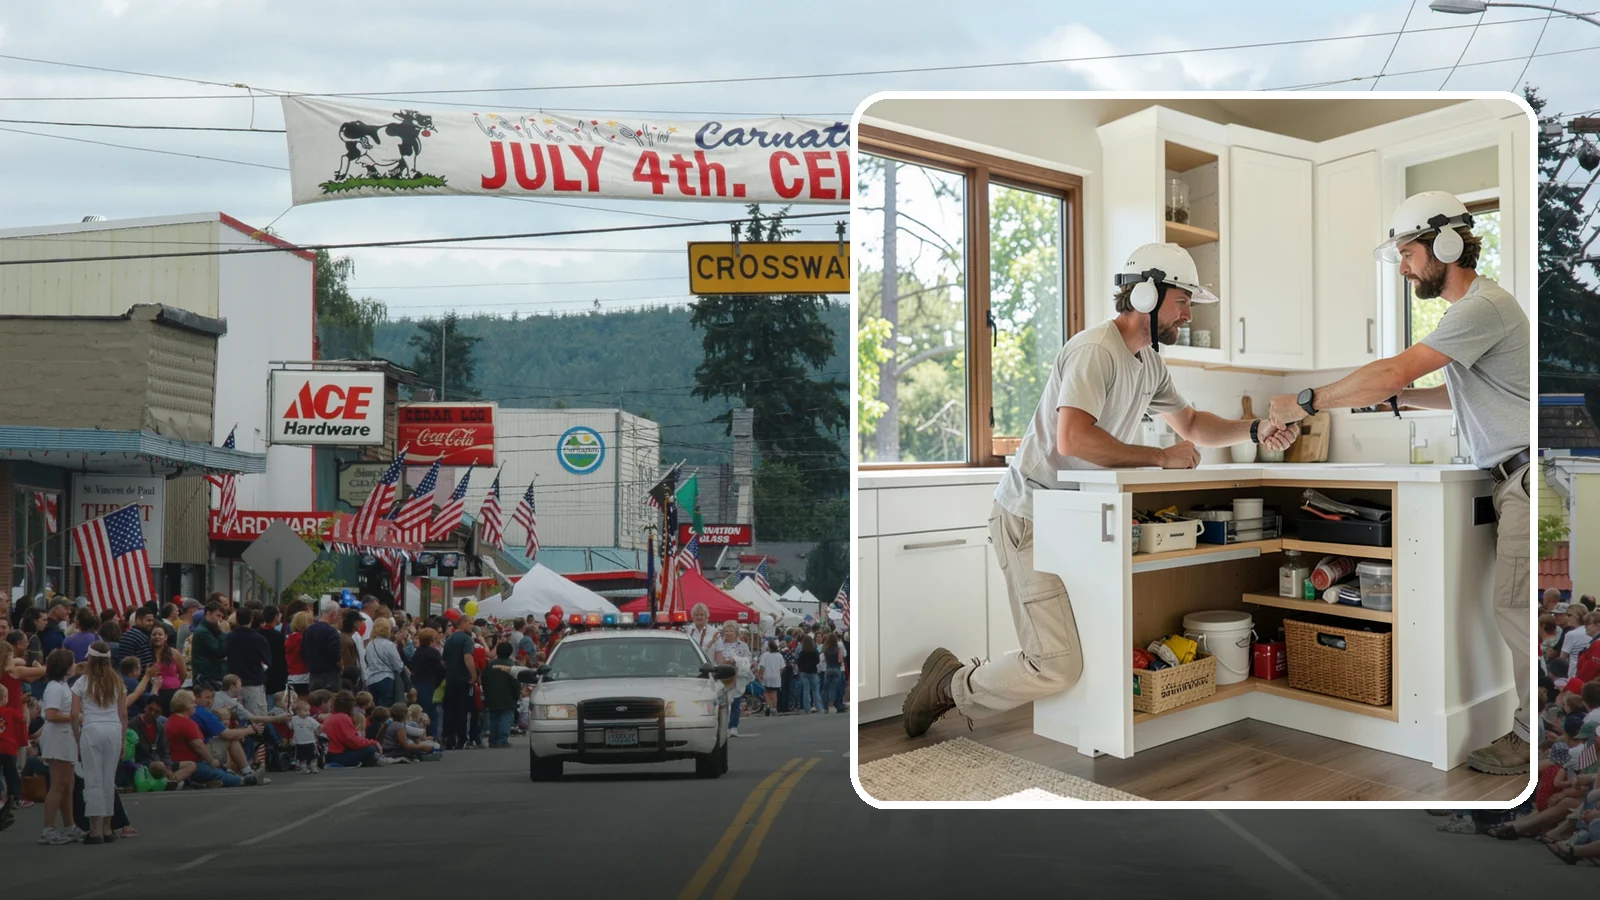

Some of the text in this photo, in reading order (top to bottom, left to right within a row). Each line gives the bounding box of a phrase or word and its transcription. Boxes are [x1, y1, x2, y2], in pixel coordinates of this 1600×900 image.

[695, 121, 850, 149] Carnat
[481, 141, 605, 192] JULY
[632, 150, 746, 197] 4th.
[697, 254, 850, 280] CROSSWA
[283, 380, 373, 420] ACE
[406, 409, 452, 421] CEDAR
[283, 421, 370, 436] Hardware
[416, 428, 477, 447] Coca-Cola
[354, 467, 386, 479] Simpl
[95, 484, 124, 495] Vincent
[126, 485, 135, 495] de
[137, 486, 155, 495] Paul
[212, 516, 331, 535] HARDARE
[688, 526, 741, 535] CRNATION
[699, 535, 730, 543] GLASS
